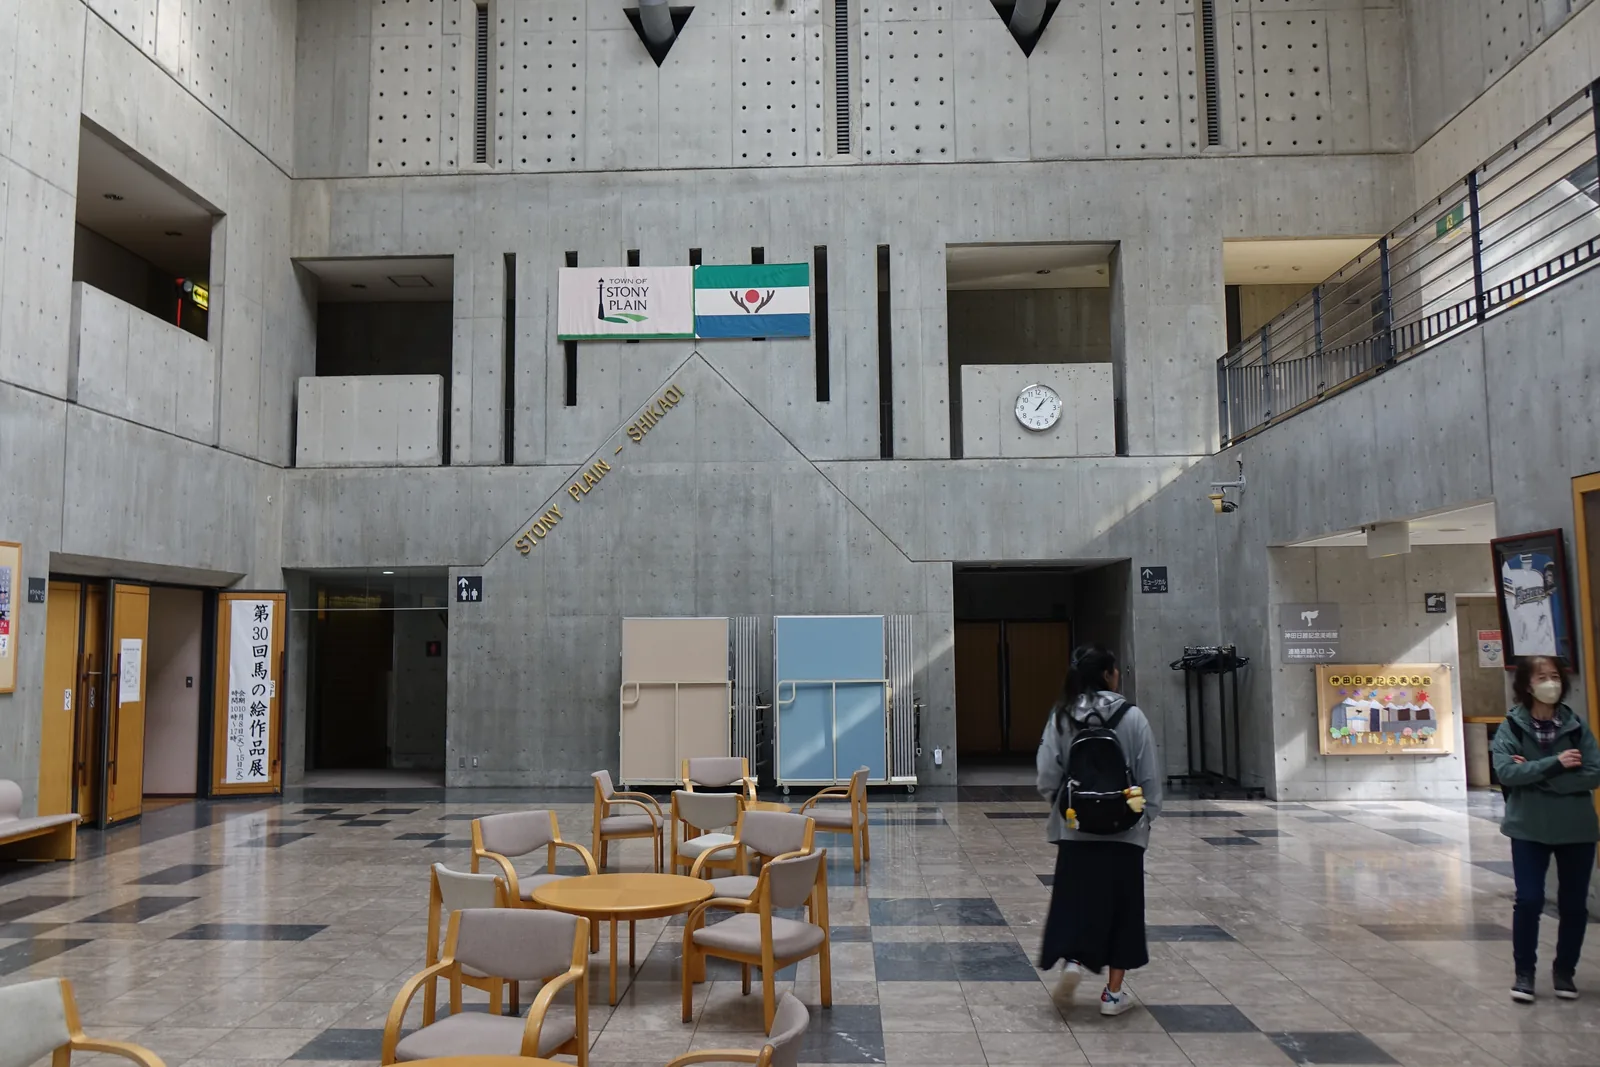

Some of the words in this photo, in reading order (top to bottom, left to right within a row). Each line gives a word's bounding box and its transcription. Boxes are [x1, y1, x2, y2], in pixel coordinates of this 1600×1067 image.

[606, 287, 649, 297] STONY
[609, 300, 647, 310] PLAIN
[515, 503, 563, 554] STONY
[568, 458, 612, 502] PLAIN
[627, 385, 685, 442] SHIKAOI
[248, 604, 269, 777] 第30回馬の絵作品展
[65, 691, 70, 708] ひく
